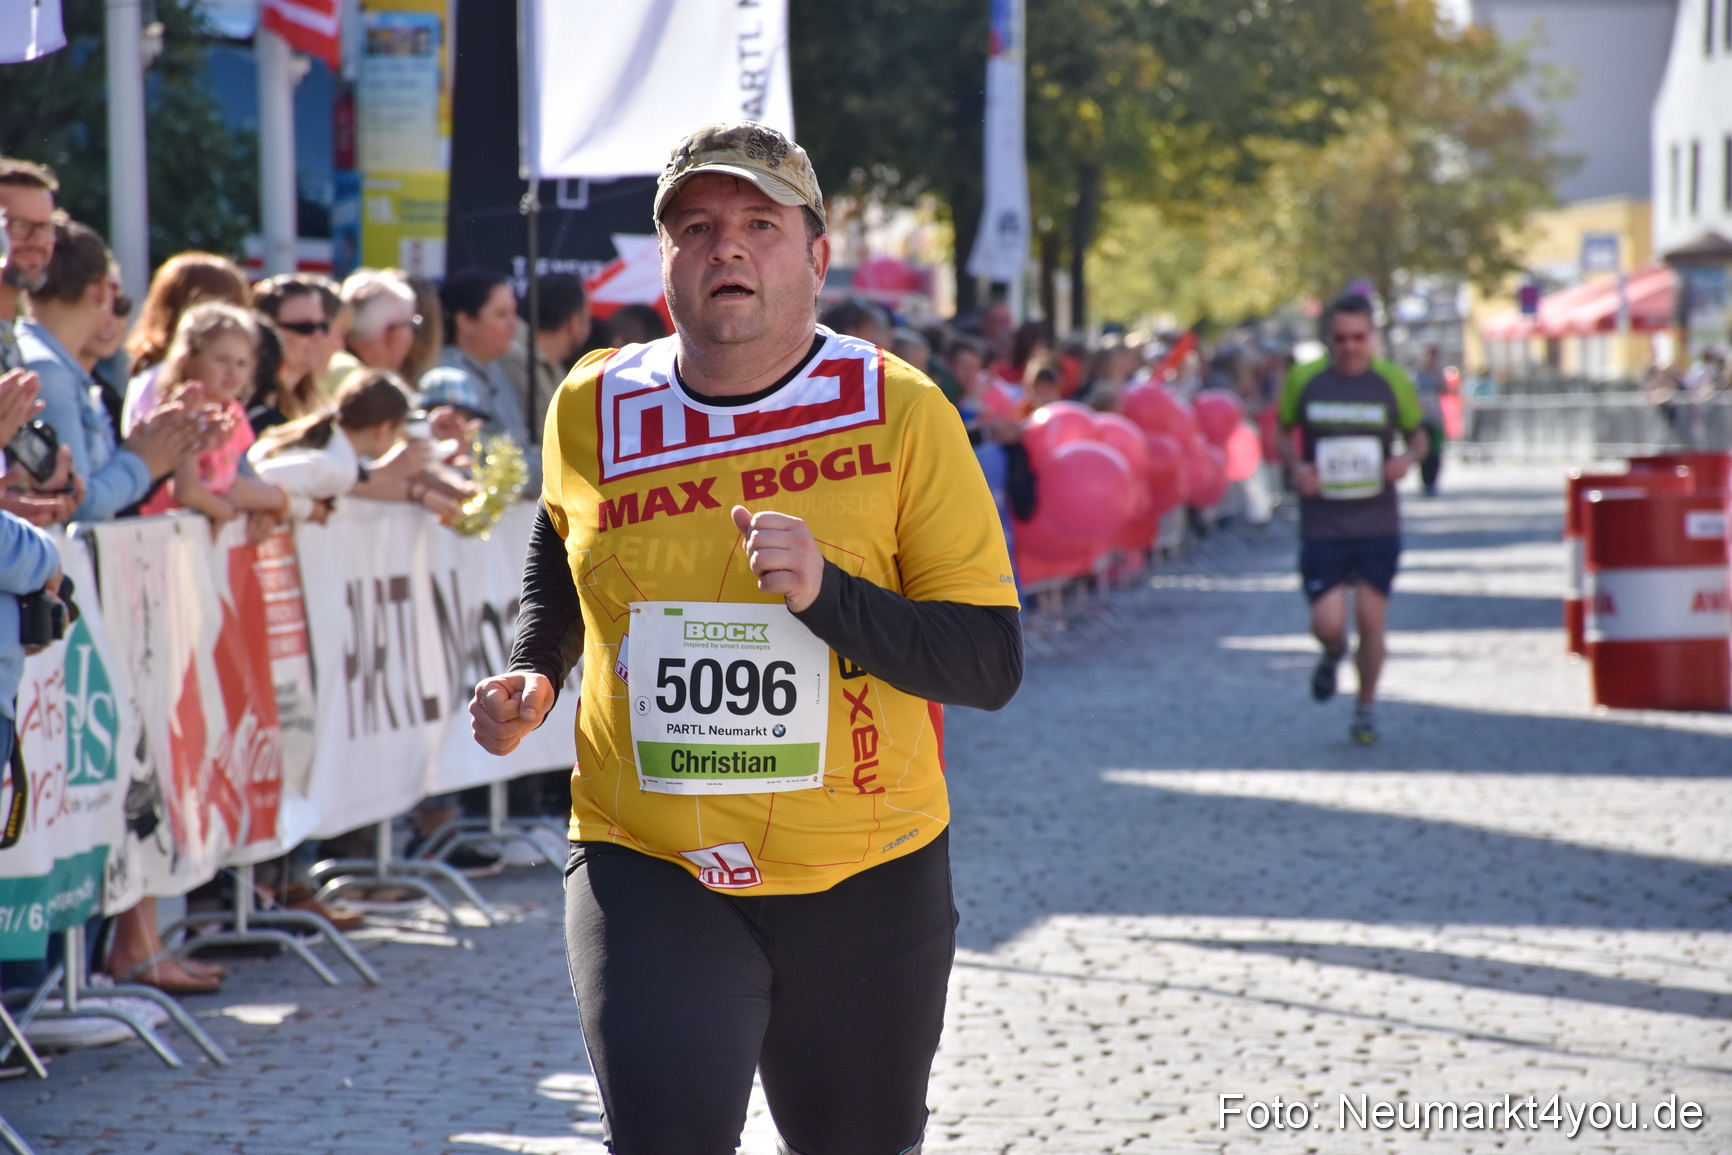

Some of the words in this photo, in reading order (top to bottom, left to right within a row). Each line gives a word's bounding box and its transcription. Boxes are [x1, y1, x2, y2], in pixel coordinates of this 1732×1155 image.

[737, 21, 766, 121] ARTL
[598, 477, 722, 533] MAX
[741, 444, 892, 501] BÖGL
[684, 621, 770, 643] BOCK
[683, 641, 709, 649] inspired
[710, 642, 719, 650] by
[656, 657, 797, 716] 5096
[640, 701, 645, 711] S
[666, 723, 706, 736] PARTL
[708, 725, 768, 737] Neumarkt
[670, 749, 777, 775] Christian
